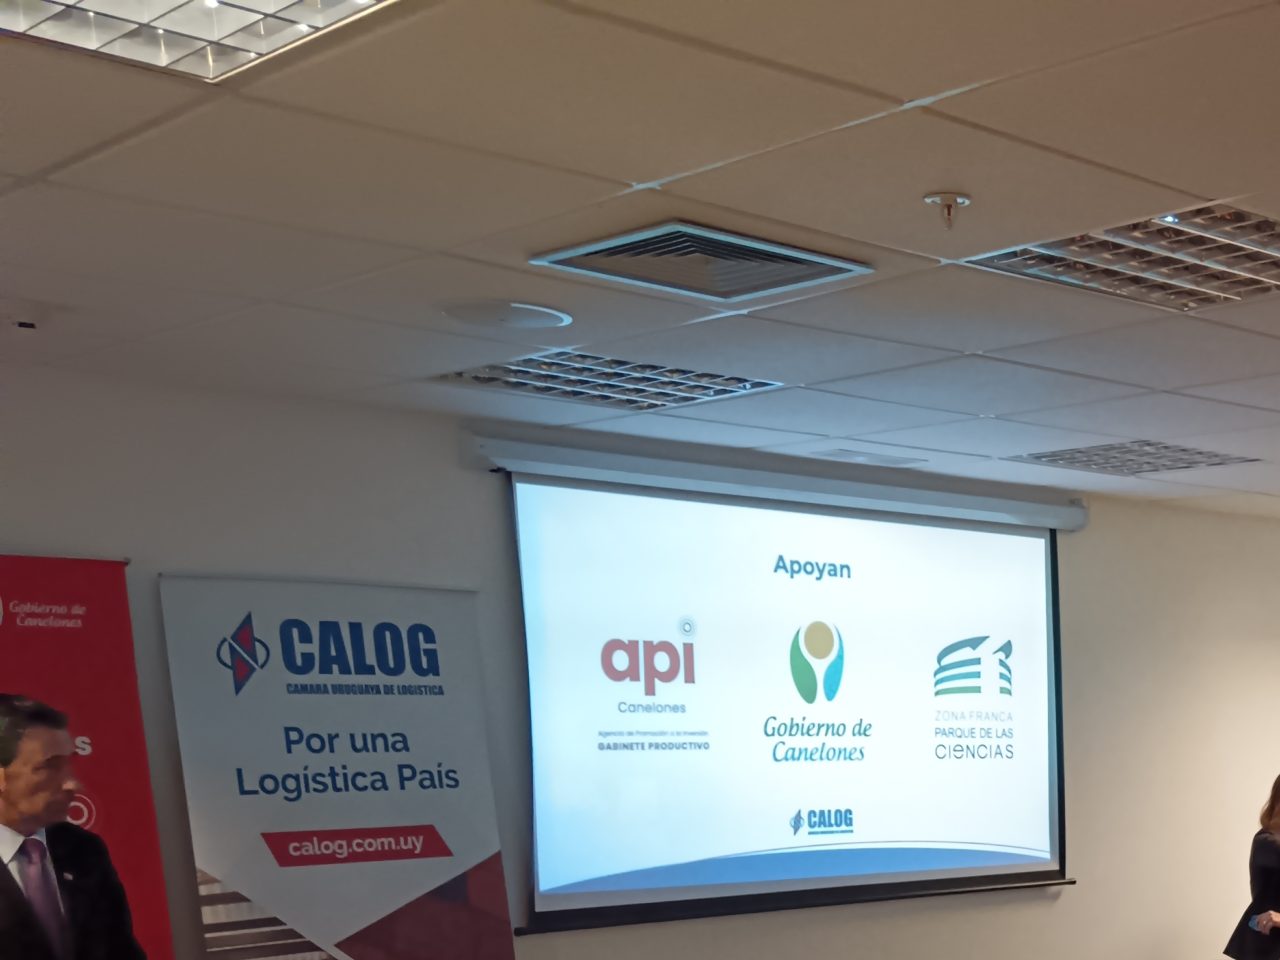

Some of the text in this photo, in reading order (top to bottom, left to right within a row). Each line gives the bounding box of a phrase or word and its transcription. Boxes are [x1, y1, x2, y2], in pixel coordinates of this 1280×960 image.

[773, 554, 851, 581] Apoyan
[279, 618, 440, 678] CALOG
[600, 621, 695, 696] api
[286, 683, 330, 695] CAMARA
[383, 685, 396, 696] DE
[397, 685, 445, 697] LOGISTICA
[617, 701, 687, 714] Canelones
[934, 709, 1013, 722] ZONA FRANCA
[763, 716, 873, 738] Gobierno de
[934, 727, 1014, 739] PARQUE DE LAS
[283, 726, 410, 754] Por una
[597, 741, 710, 751] GABINETE PRODUCTIVO
[771, 740, 866, 763] Canelones
[235, 762, 460, 802] Logística País
[807, 808, 855, 829] CALOG
[288, 835, 424, 858] calog.com.uy
